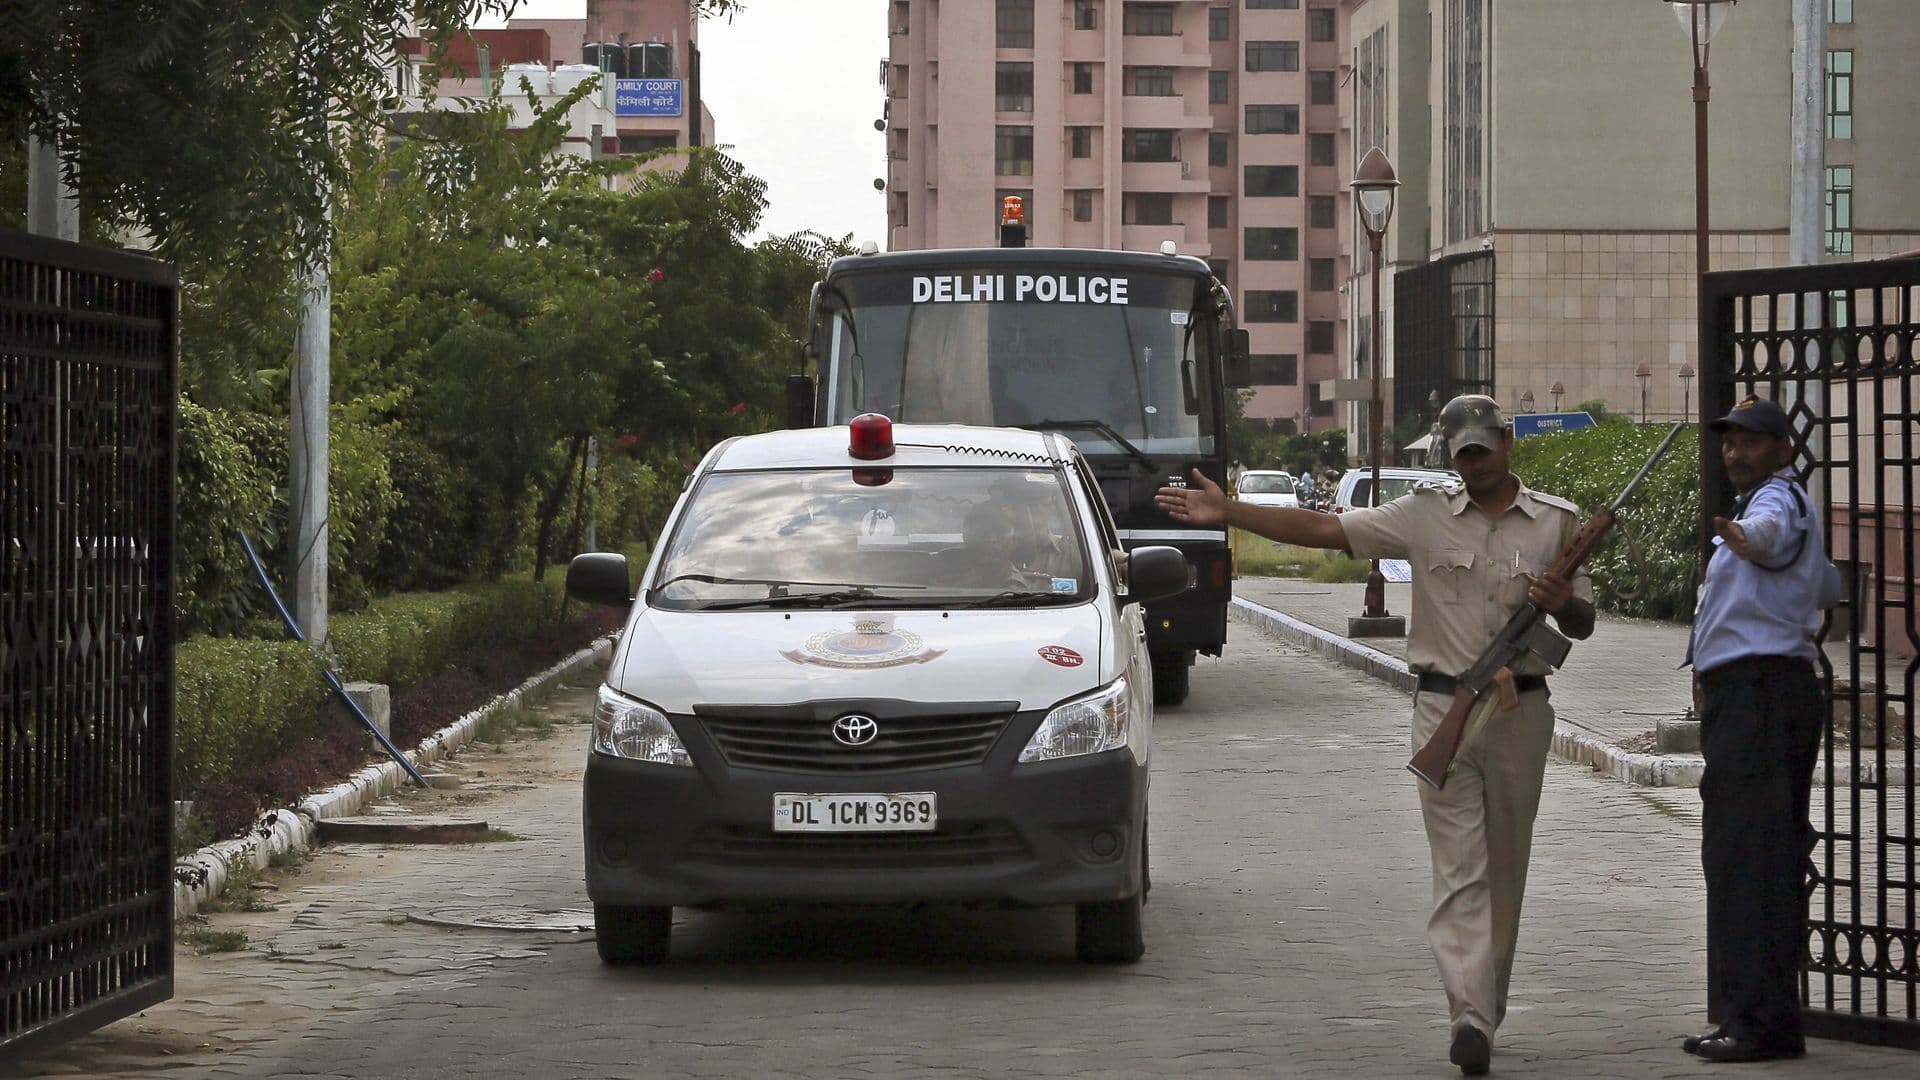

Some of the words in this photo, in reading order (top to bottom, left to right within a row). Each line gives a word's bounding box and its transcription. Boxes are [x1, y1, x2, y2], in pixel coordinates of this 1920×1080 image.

[616, 82, 643, 91] AMILY
[646, 81, 678, 91] COURT
[912, 275, 1004, 303] DELHI
[1015, 275, 1129, 304] POLICE
[792, 801, 819, 824] DL
[828, 801, 868, 825] 1CM
[874, 800, 930, 824] 9369
